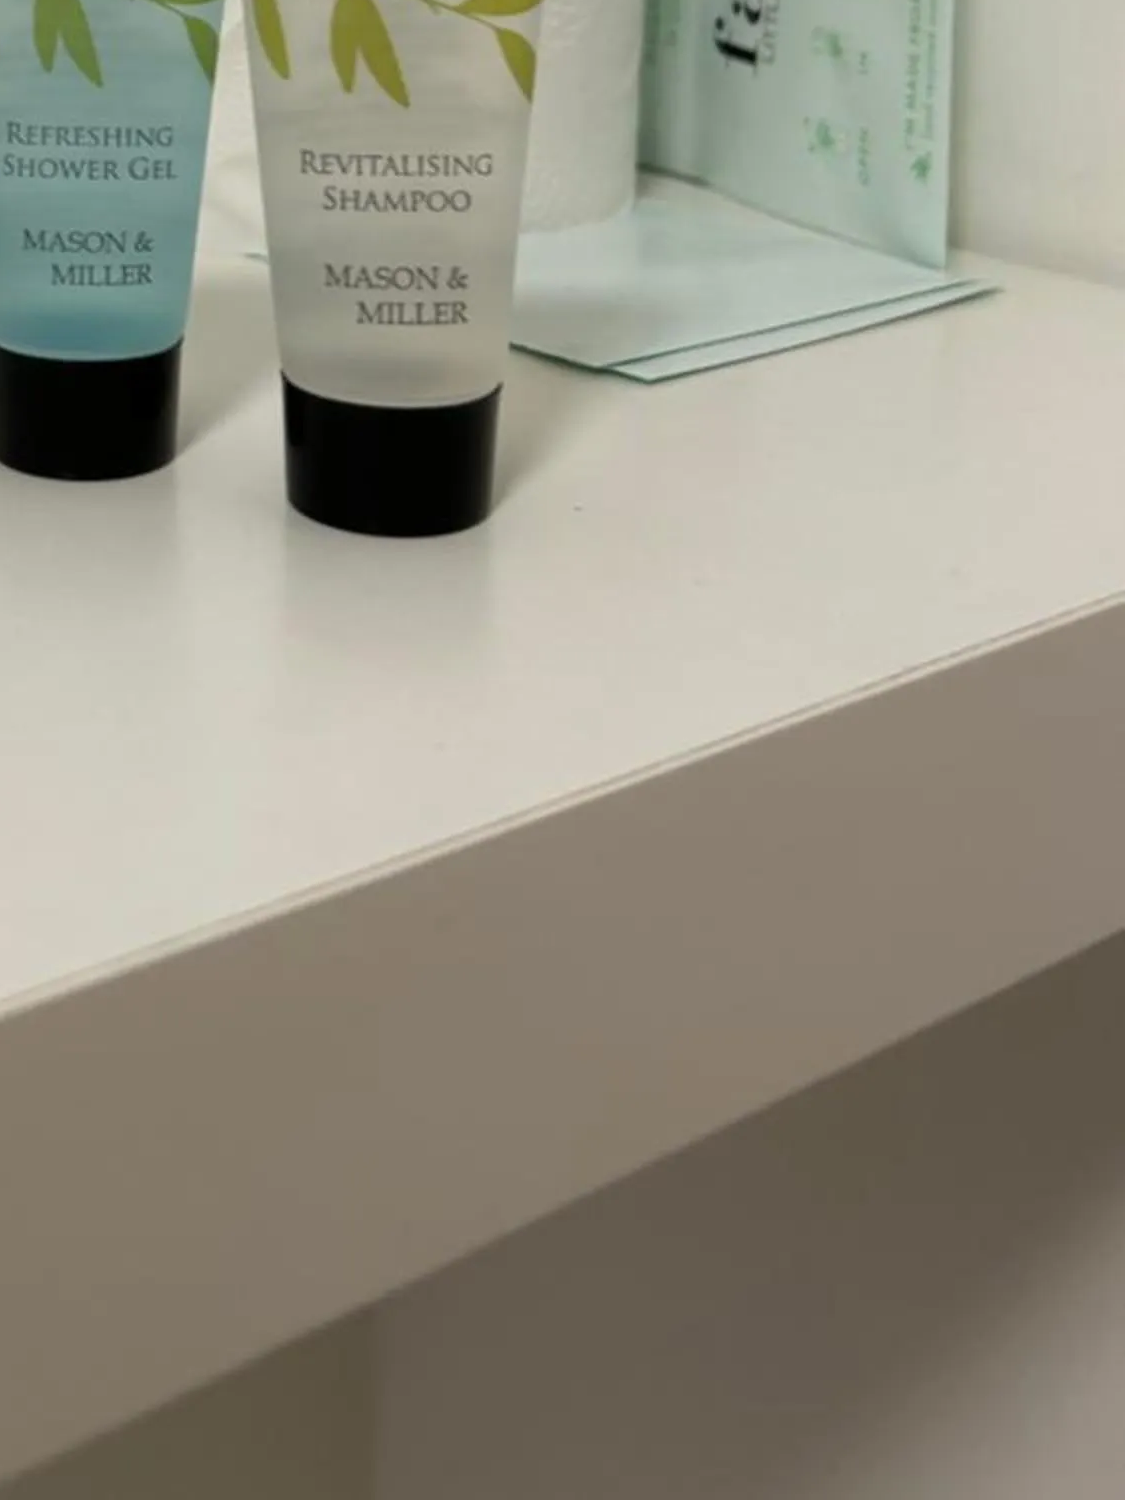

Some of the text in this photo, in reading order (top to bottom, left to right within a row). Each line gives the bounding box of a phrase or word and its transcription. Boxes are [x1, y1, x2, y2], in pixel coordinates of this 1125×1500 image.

[6, 120, 174, 148] REFRESHING
[3, 153, 179, 181] SHOWER GEL
[299, 148, 493, 177] REVITALISING
[322, 185, 473, 213] SHAMPOO
[22, 228, 155, 254] MASON &
[50, 263, 154, 287] MILLER
[324, 263, 469, 291] MASON &
[355, 300, 470, 326] MILLER
